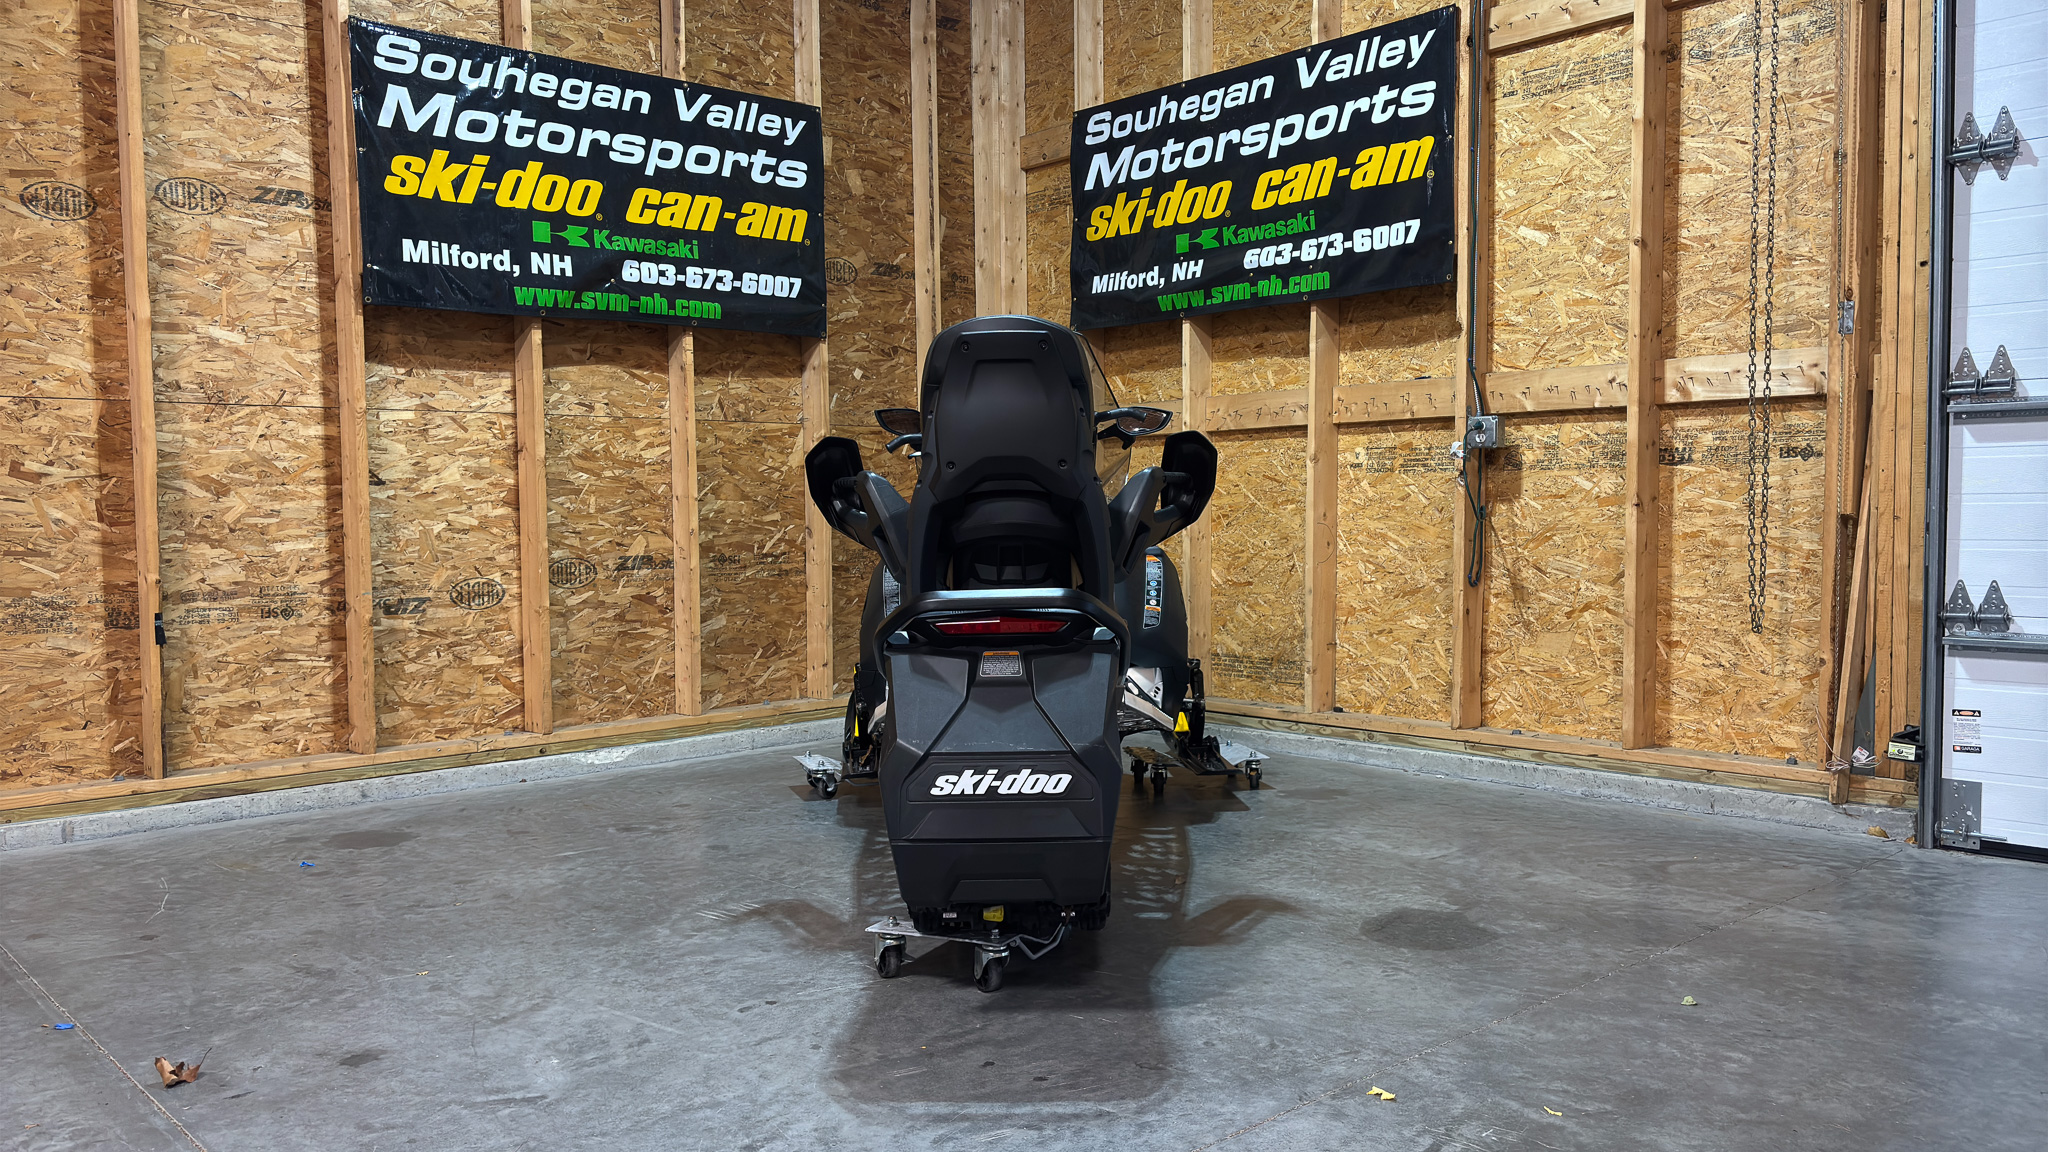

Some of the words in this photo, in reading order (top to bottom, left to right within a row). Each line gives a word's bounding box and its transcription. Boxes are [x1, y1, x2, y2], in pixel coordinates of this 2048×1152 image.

[374, 34, 651, 114] Souhegan
[674, 88, 806, 145] Valley
[1085, 75, 1274, 145] Souhegan
[1296, 29, 1436, 89] Valley
[377, 83, 807, 188] Motorsports
[1084, 80, 1436, 190] Motorsports
[384, 149, 603, 216] ski-doo
[626, 188, 807, 242] can-am
[1087, 179, 1232, 241] ski-doo
[1251, 136, 1434, 210] can-am
[594, 229, 699, 259] Kawasaki
[1223, 210, 1315, 246] Kawasaki
[1244, 219, 1420, 269] 603-673-6007
[402, 239, 519, 277] Milford,
[531, 252, 572, 276] NH
[1092, 266, 1165, 293] Milford,
[1172, 259, 1203, 282] NH
[622, 260, 801, 298] 603-673-6007
[1157, 271, 1330, 311] www.svm-nh.com
[514, 287, 721, 319] www.svm-nh.com
[930, 769, 1072, 795] ski-doo
